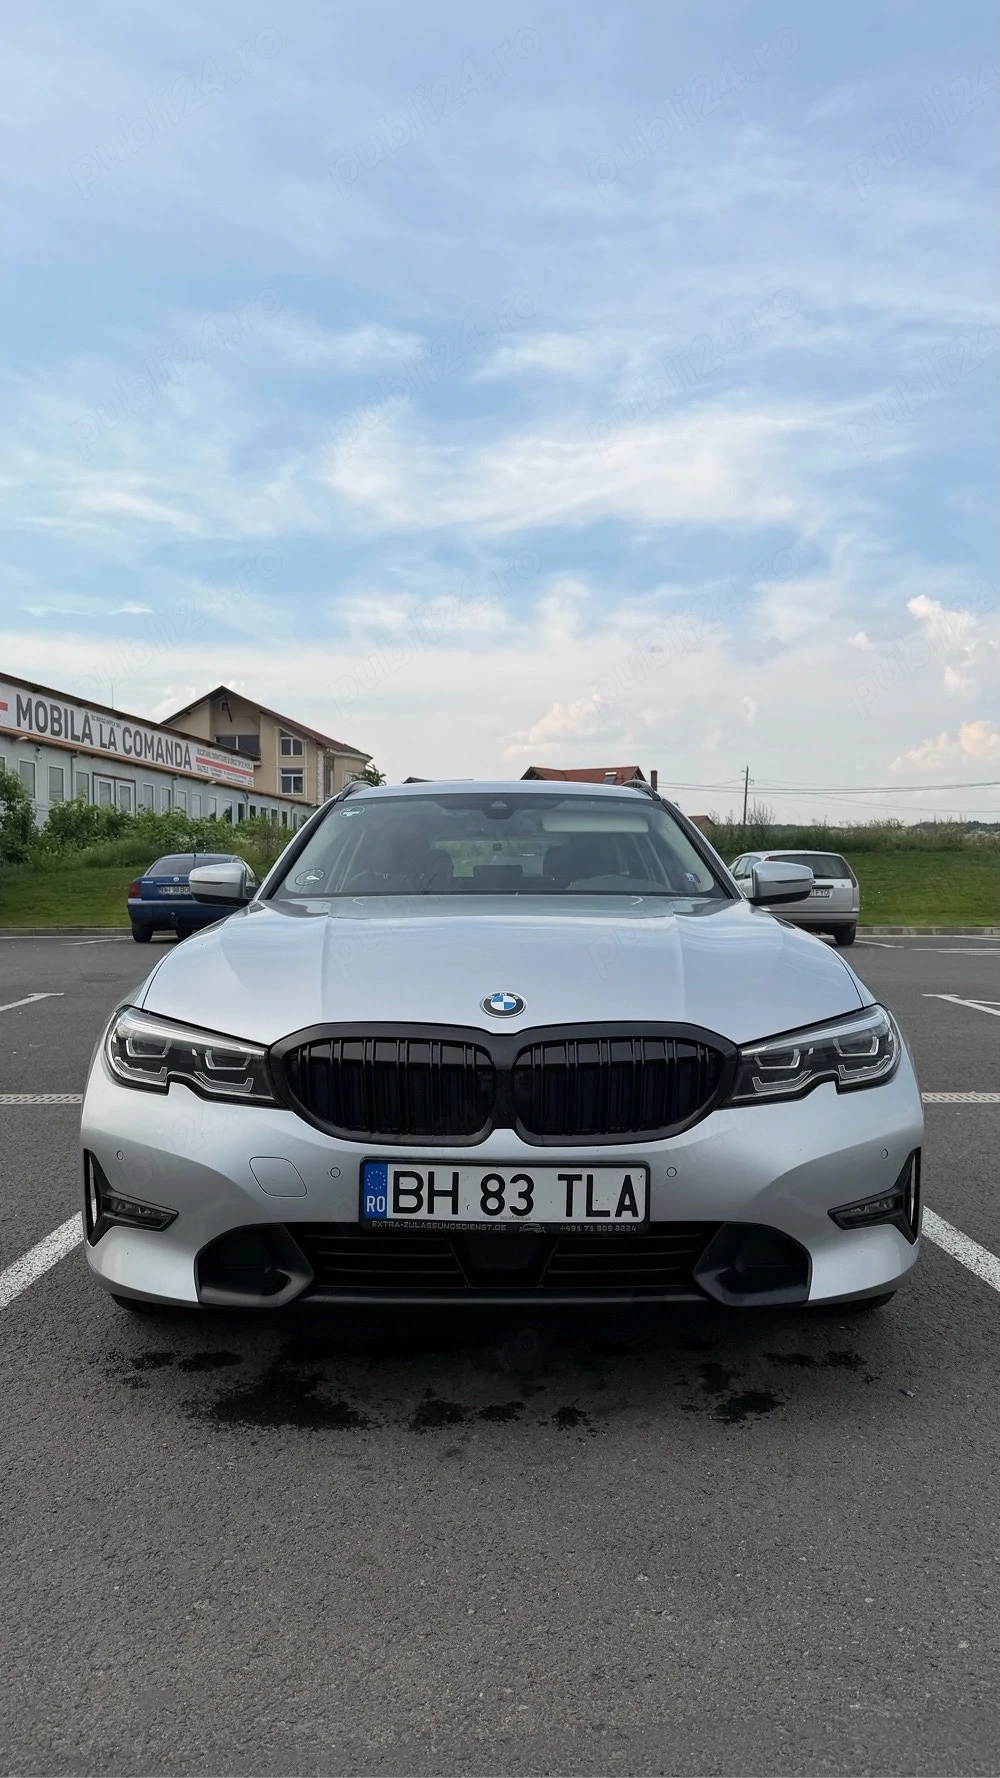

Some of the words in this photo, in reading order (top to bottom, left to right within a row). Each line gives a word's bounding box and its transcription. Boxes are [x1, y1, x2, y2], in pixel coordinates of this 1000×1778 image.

[99, 723, 118, 752] LA
[366, 1195, 387, 1213] RO
[393, 1170, 460, 1215] BH
[480, 1173, 535, 1217] 83
[557, 1173, 640, 1218] TLA
